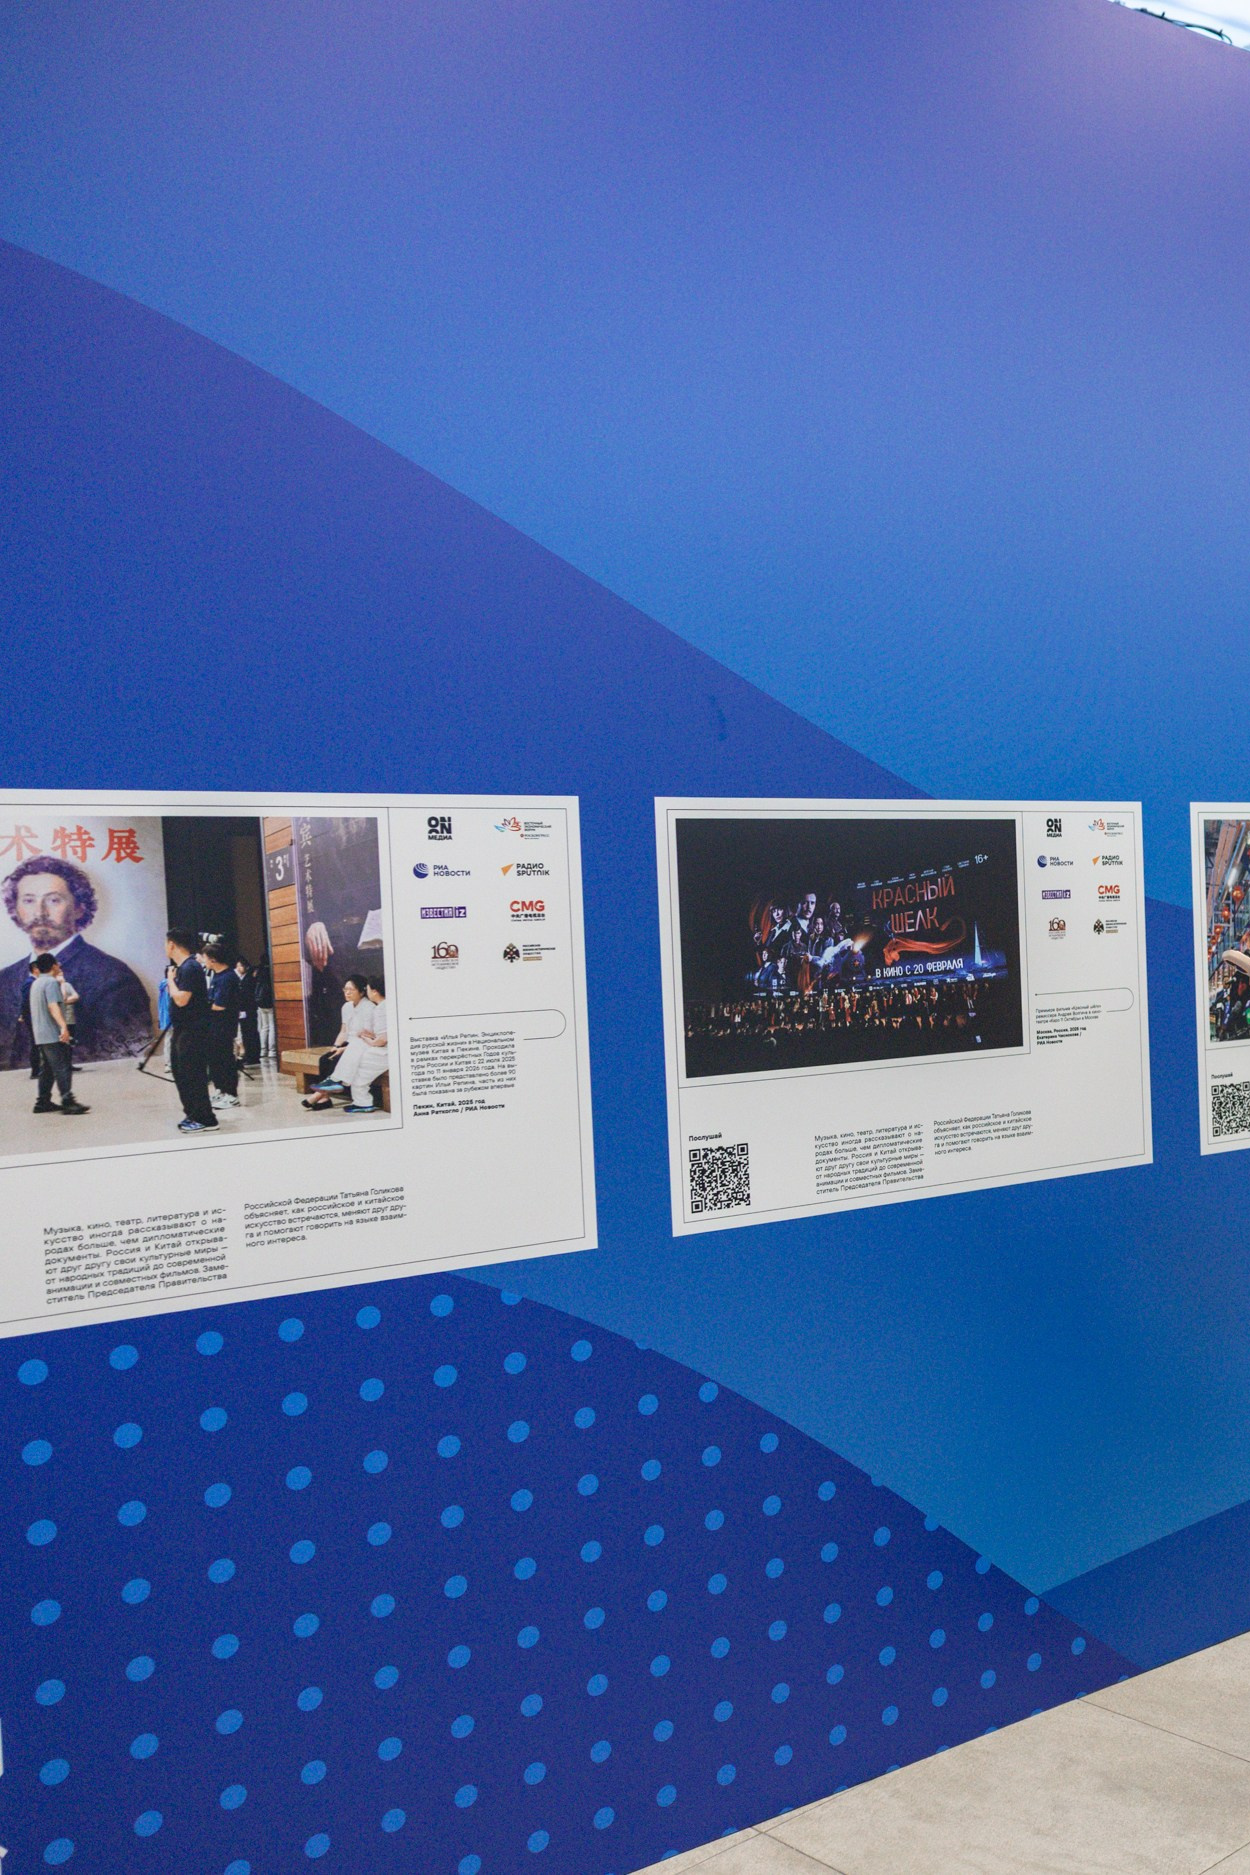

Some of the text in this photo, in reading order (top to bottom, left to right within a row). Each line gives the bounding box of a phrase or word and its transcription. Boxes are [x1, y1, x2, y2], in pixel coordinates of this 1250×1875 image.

[275, 856, 285, 881] 3
[974, 853, 989, 865] 16+
[872, 872, 955, 910] КРАСНЫЙ
[1098, 885, 1120, 895] CMG
[421, 908, 453, 918] ИЗВЕСТИЯ
[510, 900, 545, 912] CMG
[876, 958, 964, 979] В КИНО С 20 ФЕВРАЛЯ
[688, 1132, 723, 1143] Послушай
[814, 1141, 839, 1150] кусство
[864, 1132, 905, 1143] рассказывают
[875, 1125, 907, 1133] литература
[872, 1138, 922, 1149] дипломатические
[244, 1186, 404, 1210] Российской Федерации Татьяна Голикова
[307, 1201, 355, 1213] российское
[364, 1195, 404, 1204] китайское
[43, 1225, 83, 1236] Музыка,
[87, 1221, 111, 1229] кино,
[115, 1218, 143, 1226] театр,
[146, 1211, 200, 1223] литература
[244, 1218, 286, 1229] искусство
[341, 1208, 370, 1216] меняют
[371, 1205, 388, 1214] друг
[263, 1225, 304, 1236] помогают
[306, 1221, 342, 1230] говорить
[380, 1213, 407, 1221] взаим-
[43, 1234, 84, 1246] кусство
[89, 1229, 123, 1239] иногда
[128, 1220, 196, 1235] рассказывают
[44, 1246, 74, 1256] родах
[77, 1240, 116, 1251] больше,
[142, 1226, 225, 1243] дипломатические
[44, 1253, 101, 1266] документы.
[105, 1246, 141, 1256] Россия
[154, 1240, 182, 1250] Китай
[185, 1236, 227, 1246] открыва-
[60, 1264, 82, 1274] друг
[84, 1261, 111, 1270] другу
[113, 1257, 136, 1266] свои
[139, 1250, 191, 1263] культурные
[46, 1282, 93, 1294] анимации
[102, 1274, 158, 1287] совместных
[159, 1268, 200, 1279] фильмов.
[202, 1264, 228, 1272] Заме-
[58, 1271, 104, 1283] народных
[107, 1263, 150, 1277] традиций
[166, 1253, 226, 1268] современной
[46, 1273, 227, 1304] ститель Председателя Правительства
